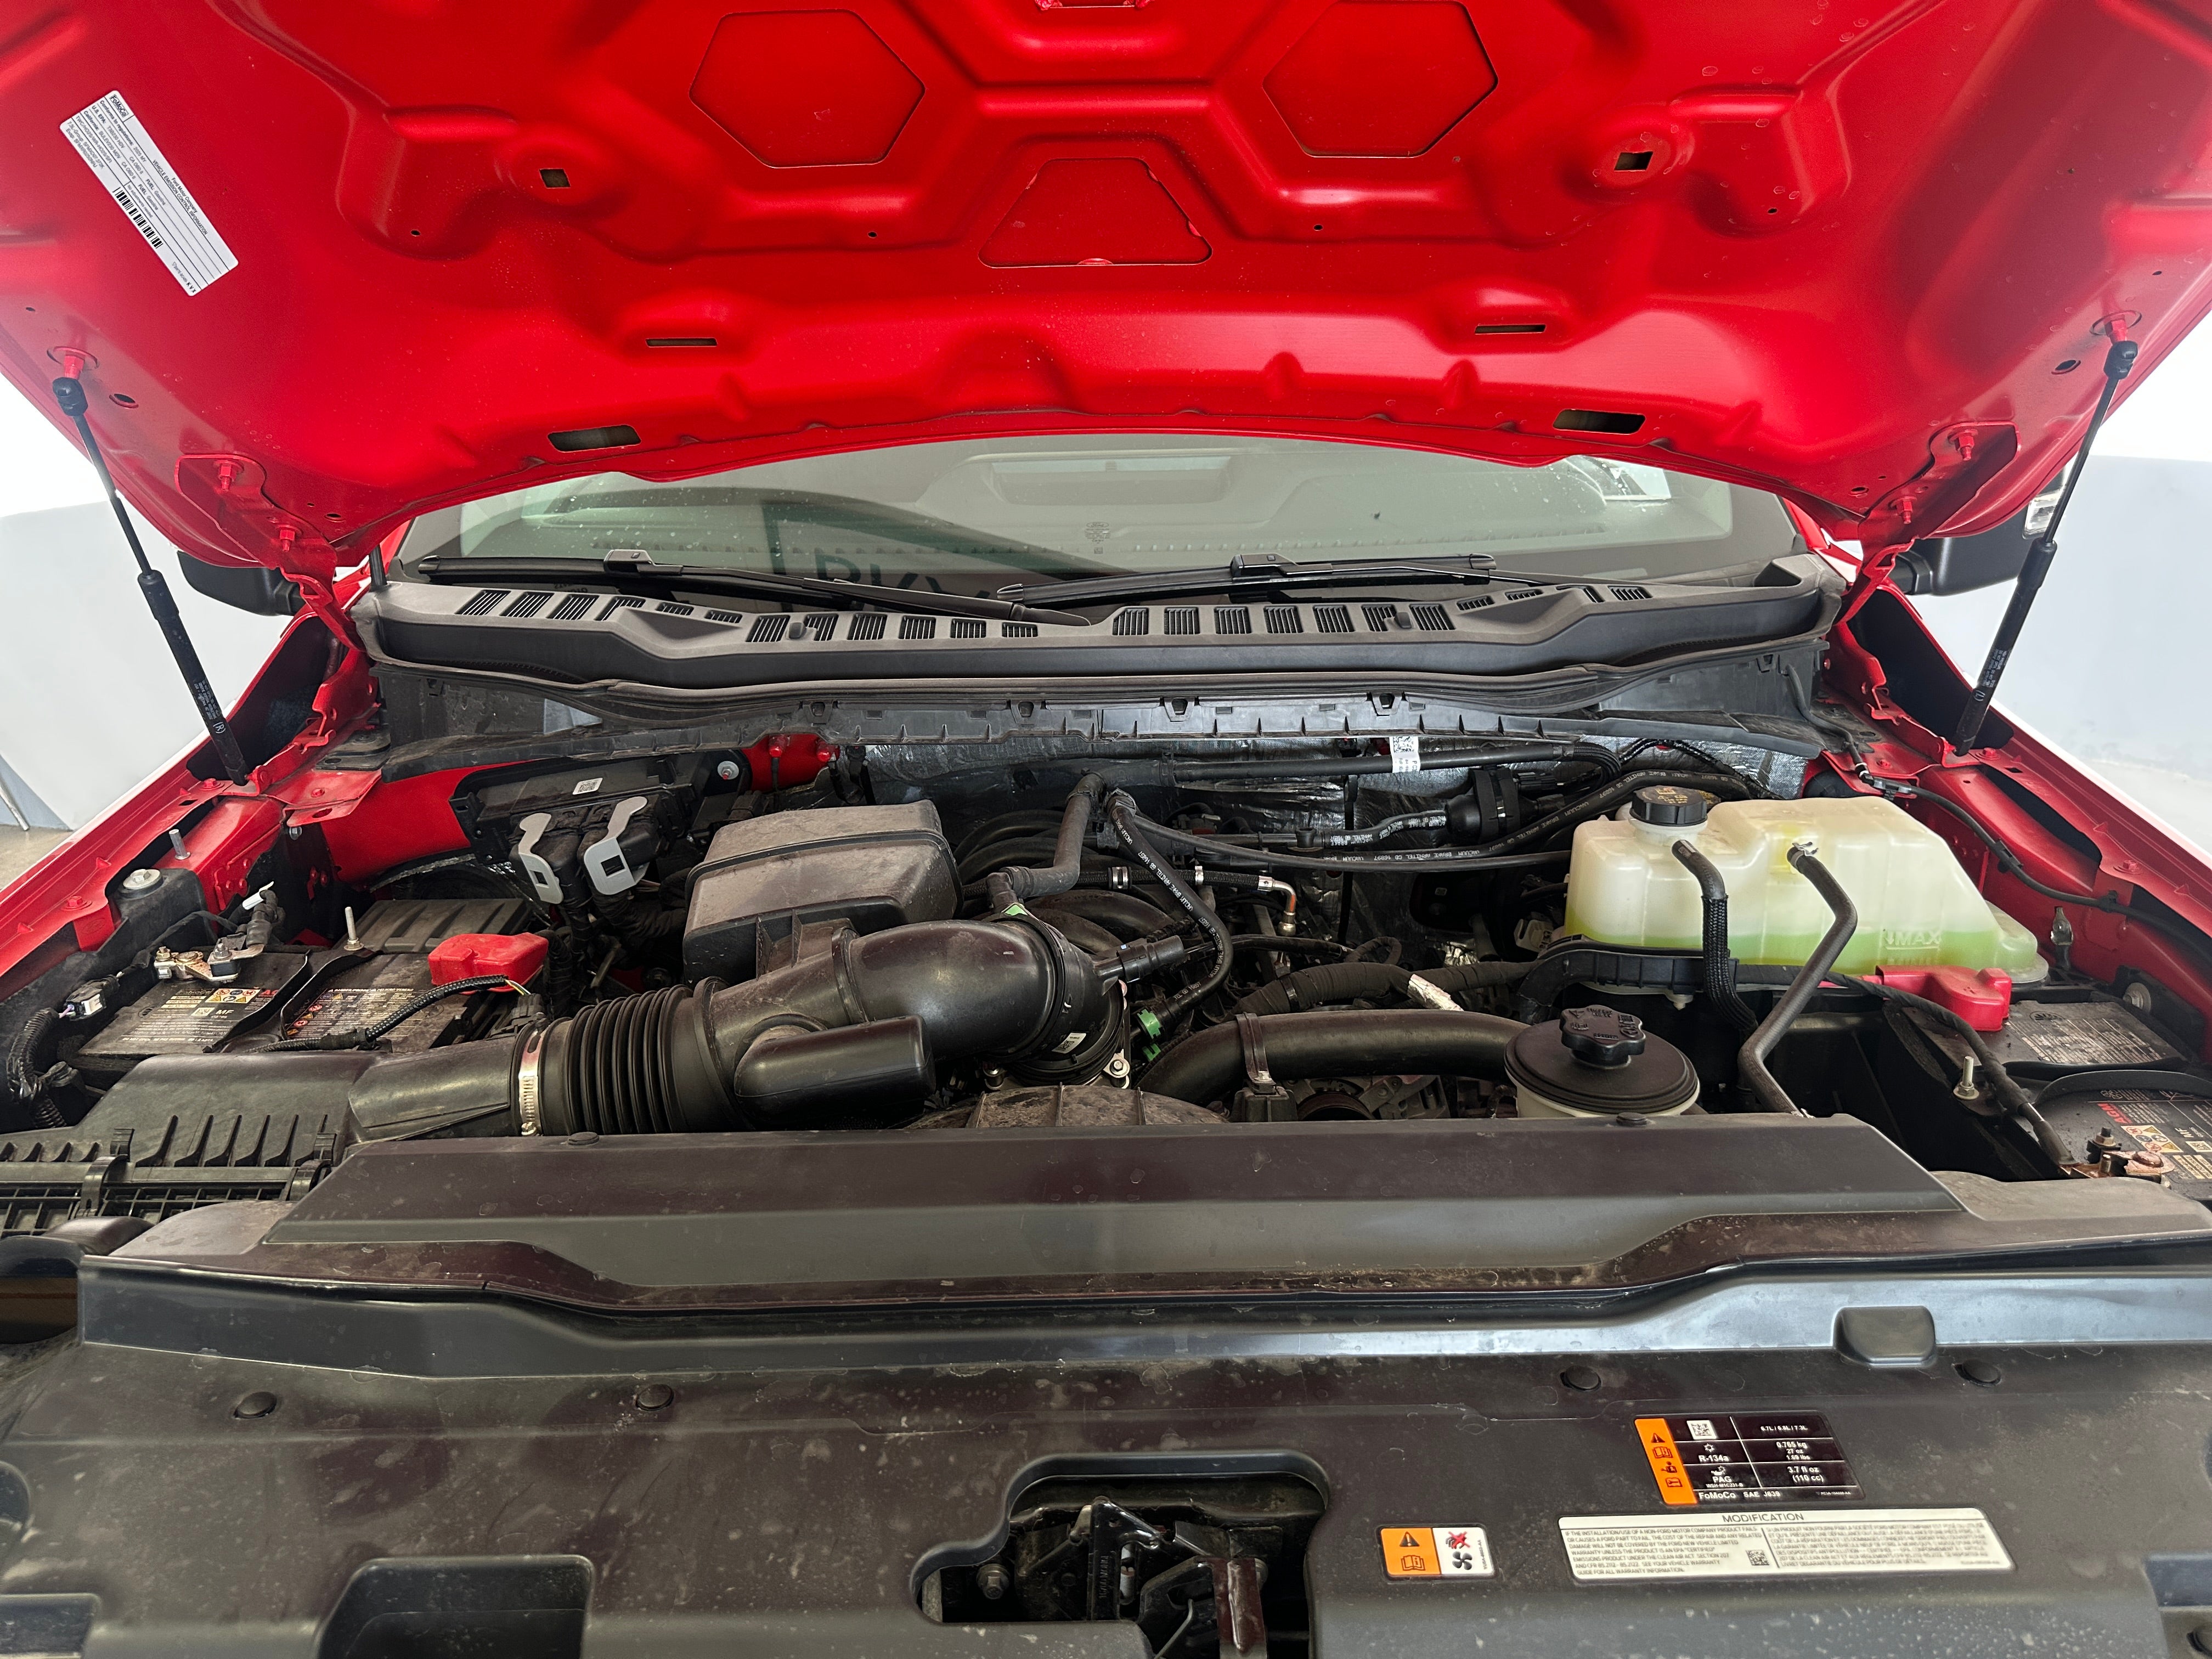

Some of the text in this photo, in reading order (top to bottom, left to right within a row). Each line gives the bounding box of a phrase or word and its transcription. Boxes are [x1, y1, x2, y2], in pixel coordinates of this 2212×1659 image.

[109, 94, 128, 117] FoMoCo
[1972, 689, 1986, 703] (L)
[212, 720, 227, 735] (R)
[1896, 931, 1940, 945] MAX
[2097, 1102, 2129, 1124] AGM
[2174, 1127, 2194, 1138] MF
[1697, 1454, 1730, 1462] R-134a
[1809, 1474, 1825, 1482] cc)
[1721, 1513, 1804, 1522] MODIFICATION
